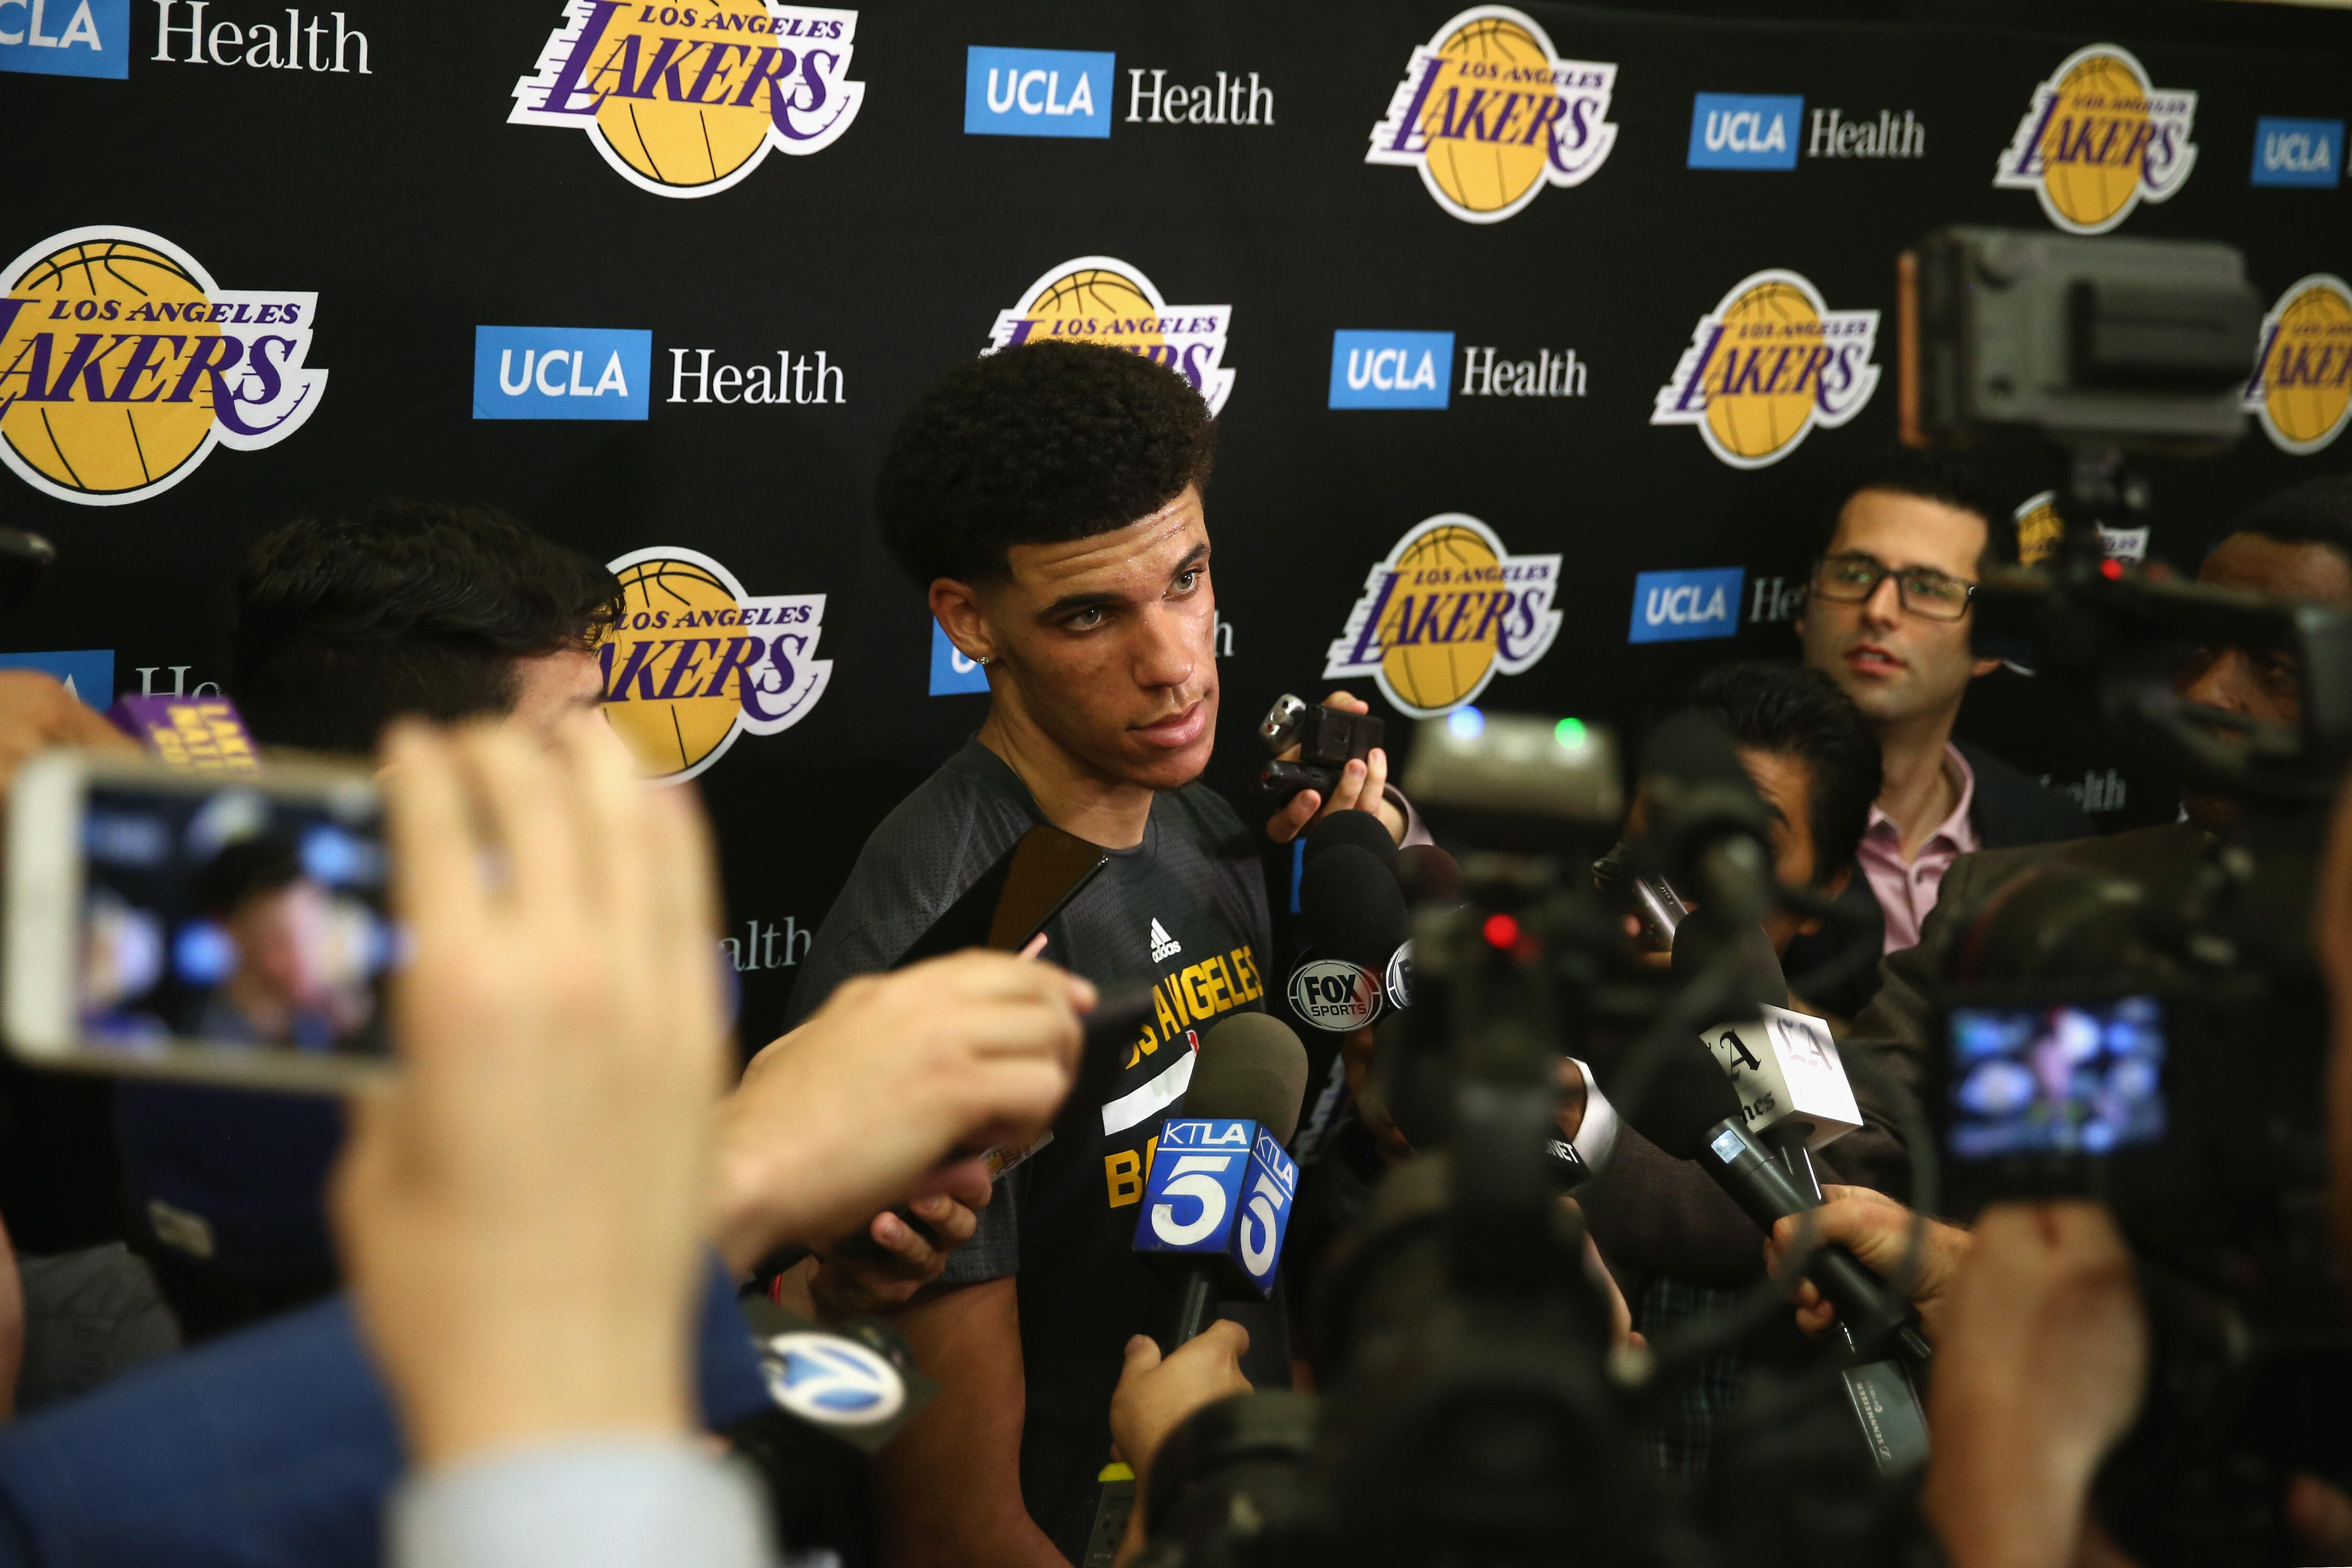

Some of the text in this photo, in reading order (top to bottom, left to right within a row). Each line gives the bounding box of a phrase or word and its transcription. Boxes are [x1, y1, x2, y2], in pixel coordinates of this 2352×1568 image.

[151, 0, 372, 74] Health
[638, 5, 843, 40] LOS ANGELES
[528, 0, 850, 140] LAKERS
[1459, 61, 1604, 89] LOS ANGELES
[986, 68, 1275, 126] UCLA Health
[1380, 55, 1607, 174] LAKERS
[1705, 108, 1925, 159] UCLA Health
[2015, 93, 2192, 189] LAKERS
[2264, 131, 2331, 173] UCLA
[49, 300, 301, 324] LOS ANGELES
[1051, 315, 1219, 335] LOS ANGELES
[498, 348, 847, 404] UCLA Health
[1347, 346, 1587, 397] UCLA Health
[1665, 324, 1873, 414] LAKERS
[1413, 563, 1550, 585] LOS ANGELES
[672, 606, 812, 629] ANGELES
[1337, 570, 1553, 661] LAKERS
[1645, 584, 1727, 627] UCLA
[1152, 940, 1182, 963] adidas
[1304, 974, 1363, 1005] FOX
[1311, 1004, 1367, 1017] SPORTS
[1163, 1123, 1247, 1145] KTLA
[1256, 1128, 1293, 1192] KTLA
[1151, 1156, 1232, 1246] 5
[1241, 1172, 1284, 1276] 5
